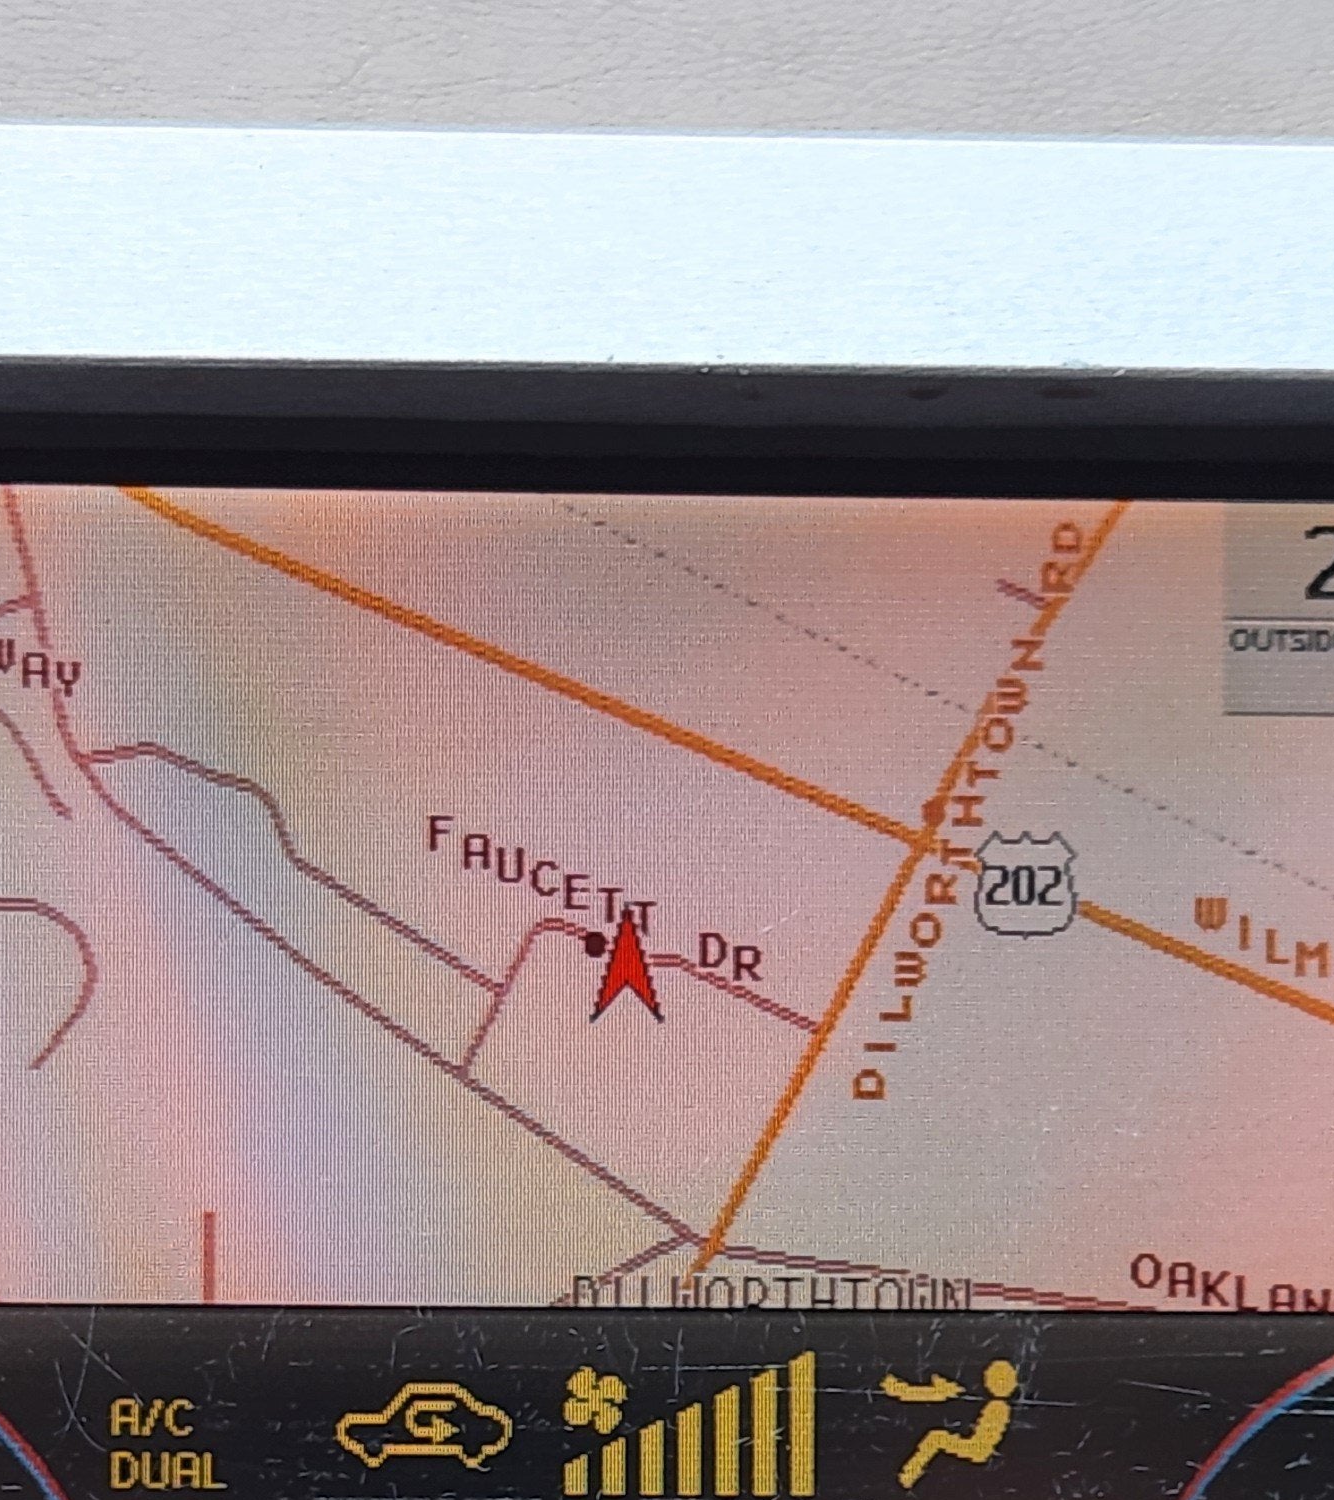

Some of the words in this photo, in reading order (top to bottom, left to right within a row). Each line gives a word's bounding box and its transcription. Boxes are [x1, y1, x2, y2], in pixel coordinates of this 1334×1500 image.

[1040, 521, 1084, 592] RD
[429, 815, 656, 935] FAUCETT
[699, 933, 762, 981] DR
[985, 865, 1063, 906] 202
[110, 1398, 195, 1437] A/C
[109, 1451, 229, 1490] DUAL
